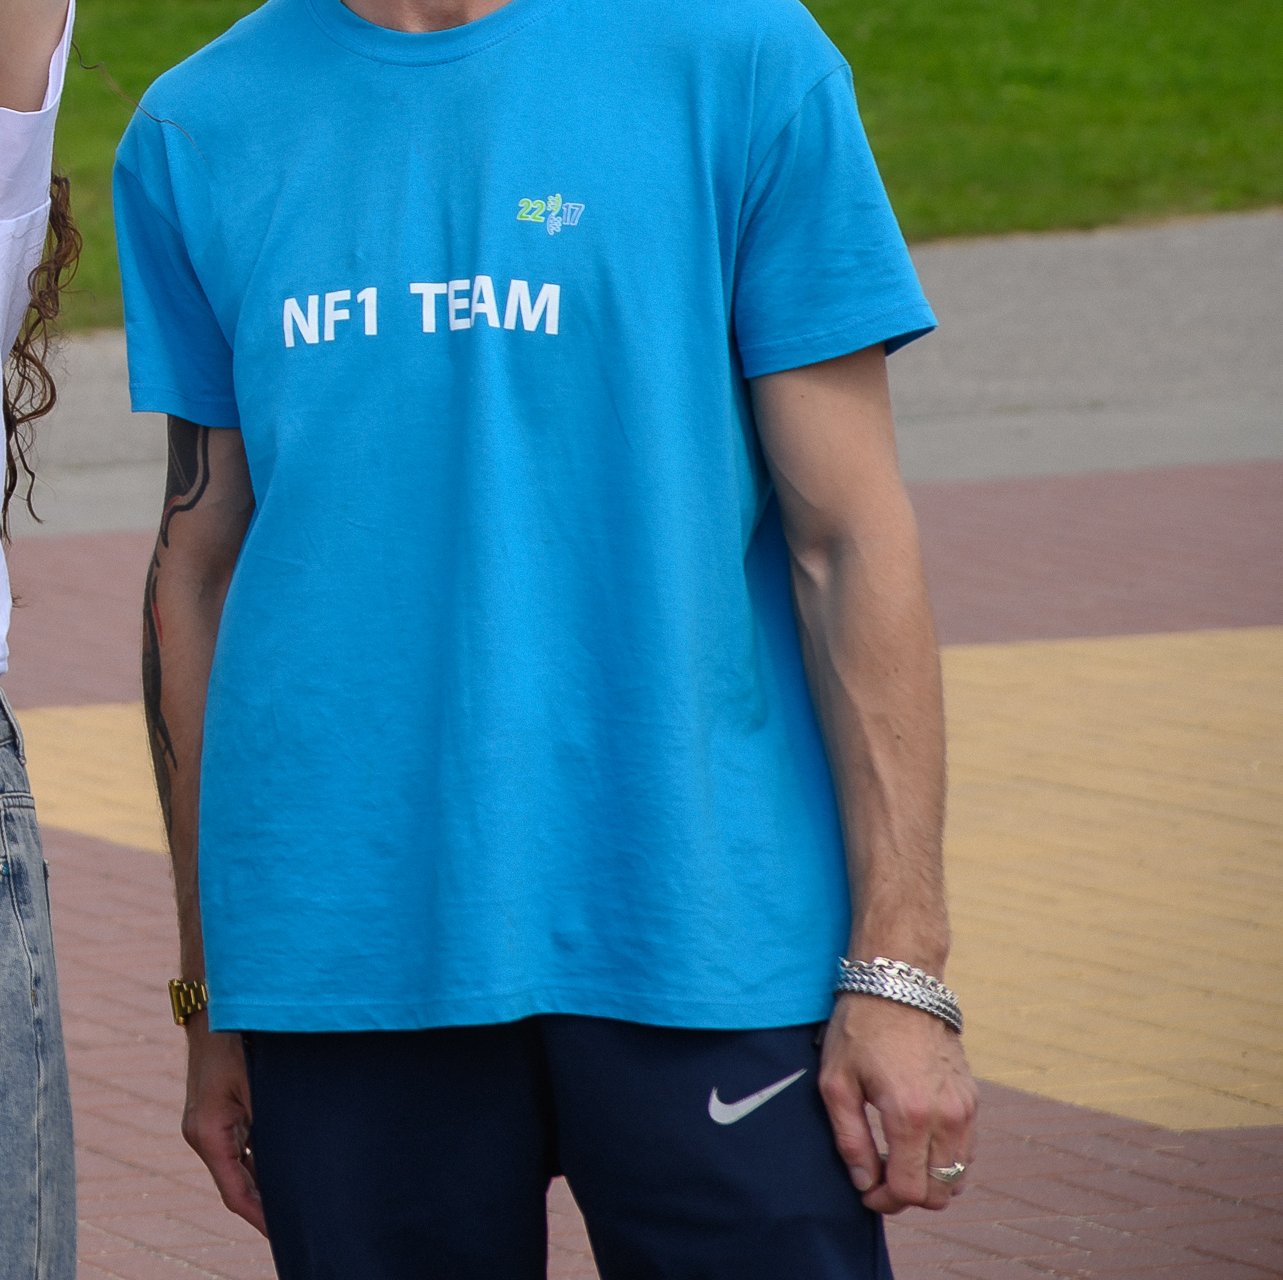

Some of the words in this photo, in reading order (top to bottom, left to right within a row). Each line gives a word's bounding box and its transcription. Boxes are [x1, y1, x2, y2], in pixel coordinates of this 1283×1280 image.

[516, 198, 546, 222] 22
[562, 202, 585, 226] 17
[283, 286, 378, 348] NF1
[409, 275, 561, 335] TEAM
